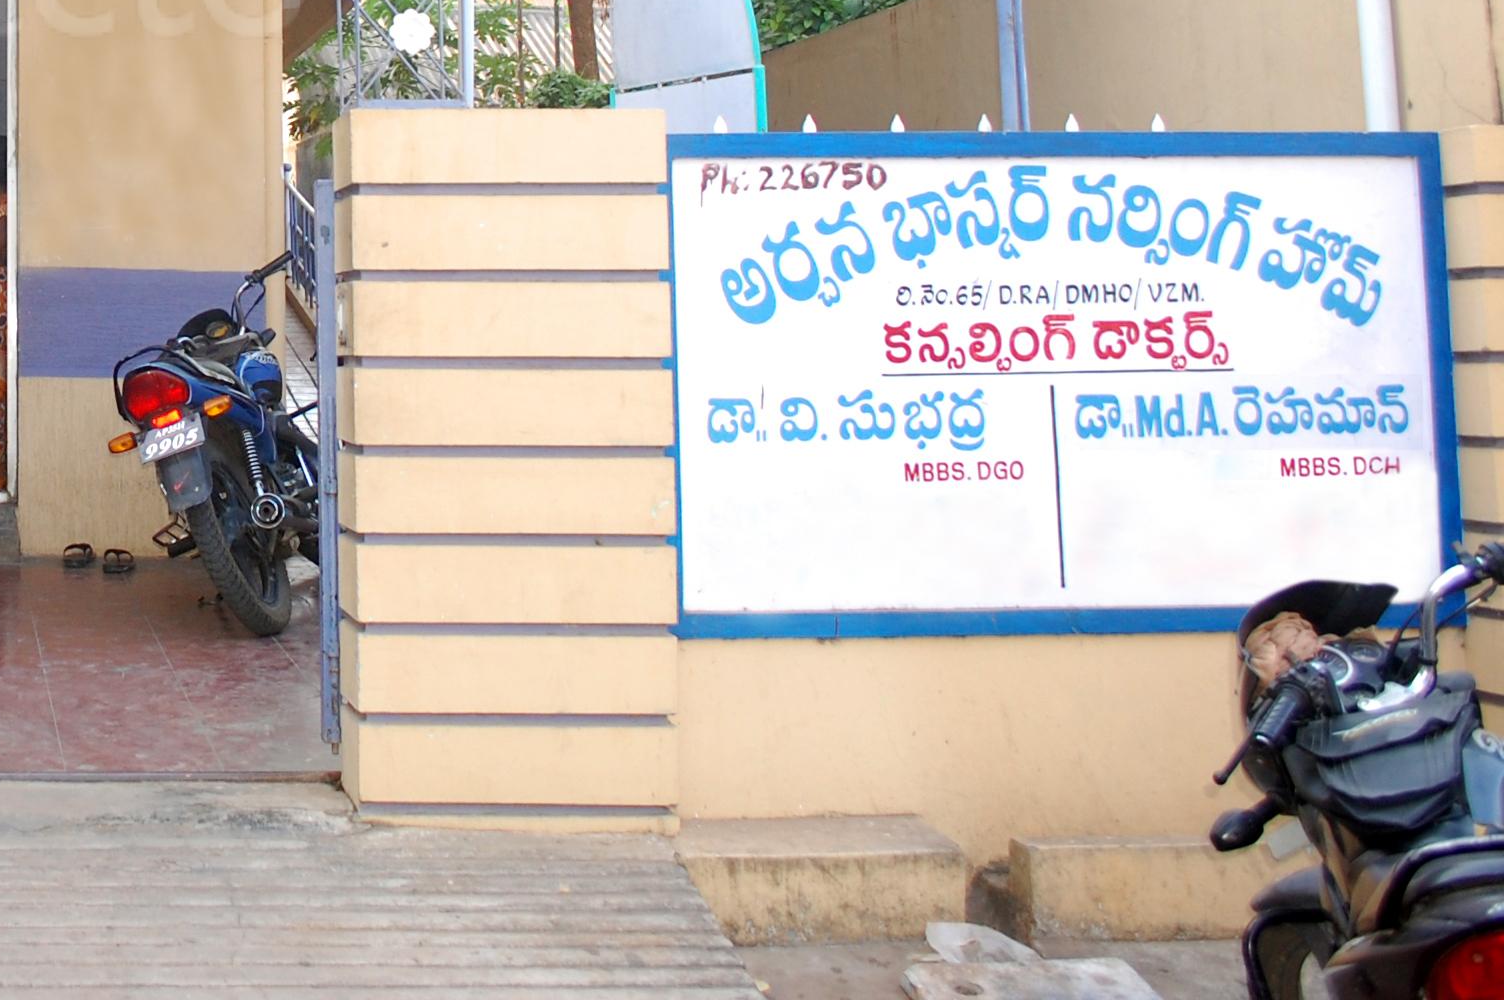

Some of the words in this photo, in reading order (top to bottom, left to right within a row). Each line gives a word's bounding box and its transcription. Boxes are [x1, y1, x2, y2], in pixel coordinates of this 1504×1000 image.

[759, 160, 888, 193] 226750
[721, 200, 877, 325] అర్చన
[882, 164, 1051, 268] భాస్కర్
[1068, 173, 1263, 271] నర్సింగ్
[882, 312, 1077, 374] కన్సల్టింగ్
[1092, 309, 1230, 371] డాక్టర్స్
[837, 388, 987, 452] సుభద్ర
[145, 427, 199, 461] 9905
[977, 460, 1025, 480] DGO
[1353, 455, 1402, 476] DCH
